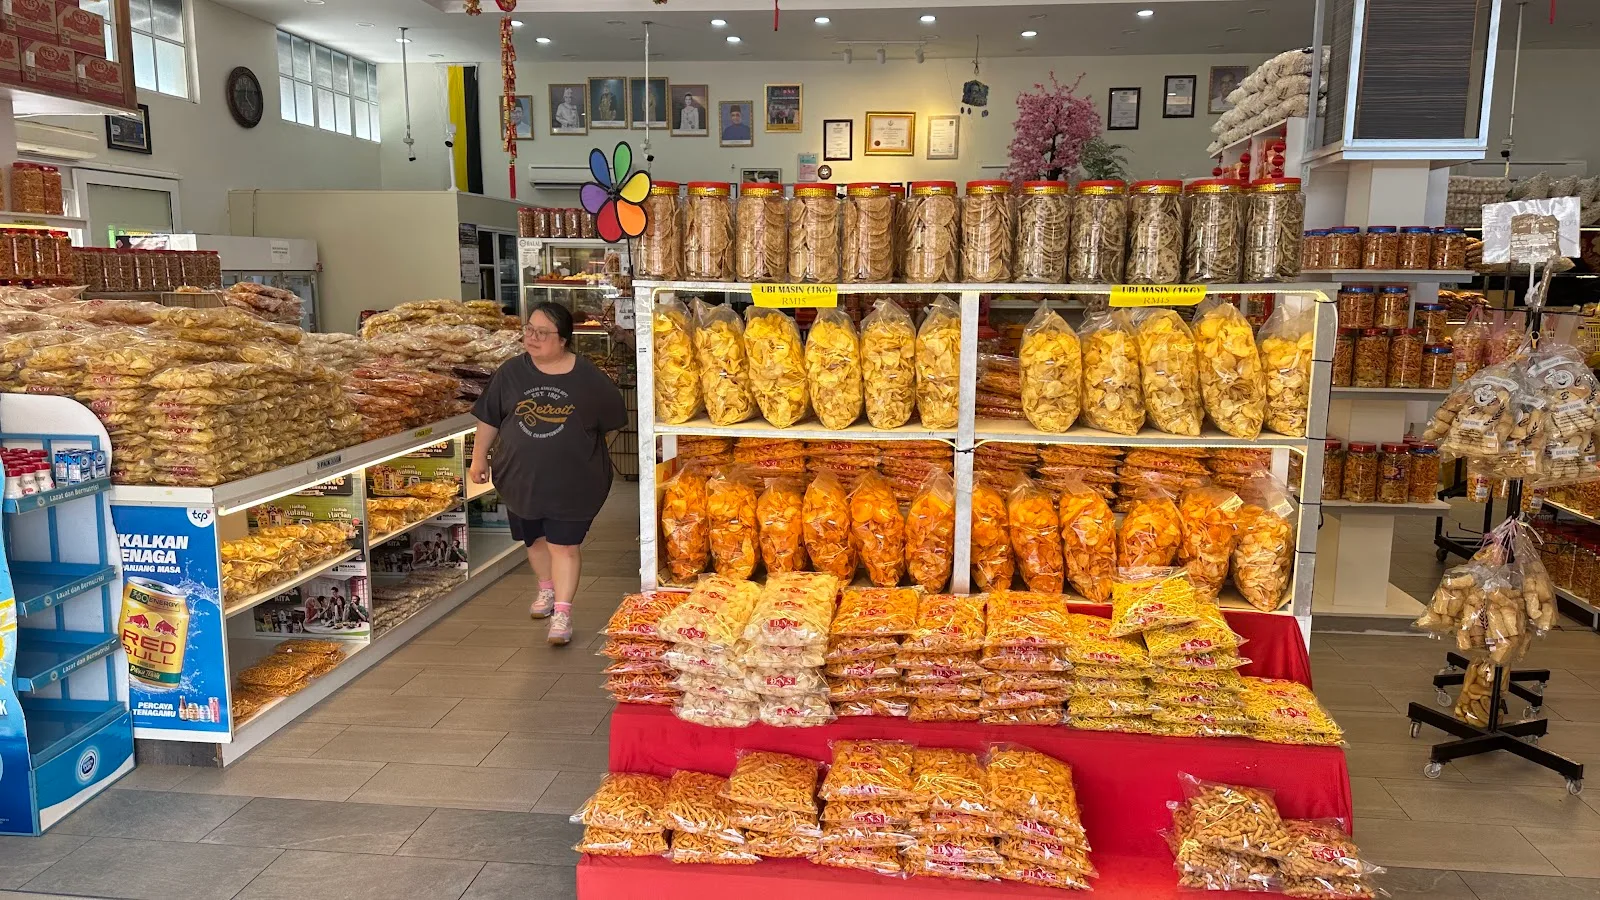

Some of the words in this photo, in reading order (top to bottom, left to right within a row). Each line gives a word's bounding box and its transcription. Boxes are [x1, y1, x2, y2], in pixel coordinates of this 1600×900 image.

[778, 286, 804, 294] MASIN
[807, 286, 832, 294] (1KG)
[782, 297, 807, 305] RM15
[118, 533, 189, 549] KALKAN
[122, 549, 177, 563] ENAGA
[149, 597, 179, 608] ENERGY
[682, 629, 704, 637] D.N.S
[123, 629, 176, 655] RED
[123, 643, 174, 665] BULL
[770, 677, 794, 685] D.N.S
[137, 702, 174, 711] PERCAYA
[132, 709, 177, 718] TENAGAMU
[858, 815, 882, 823] D.N.S
